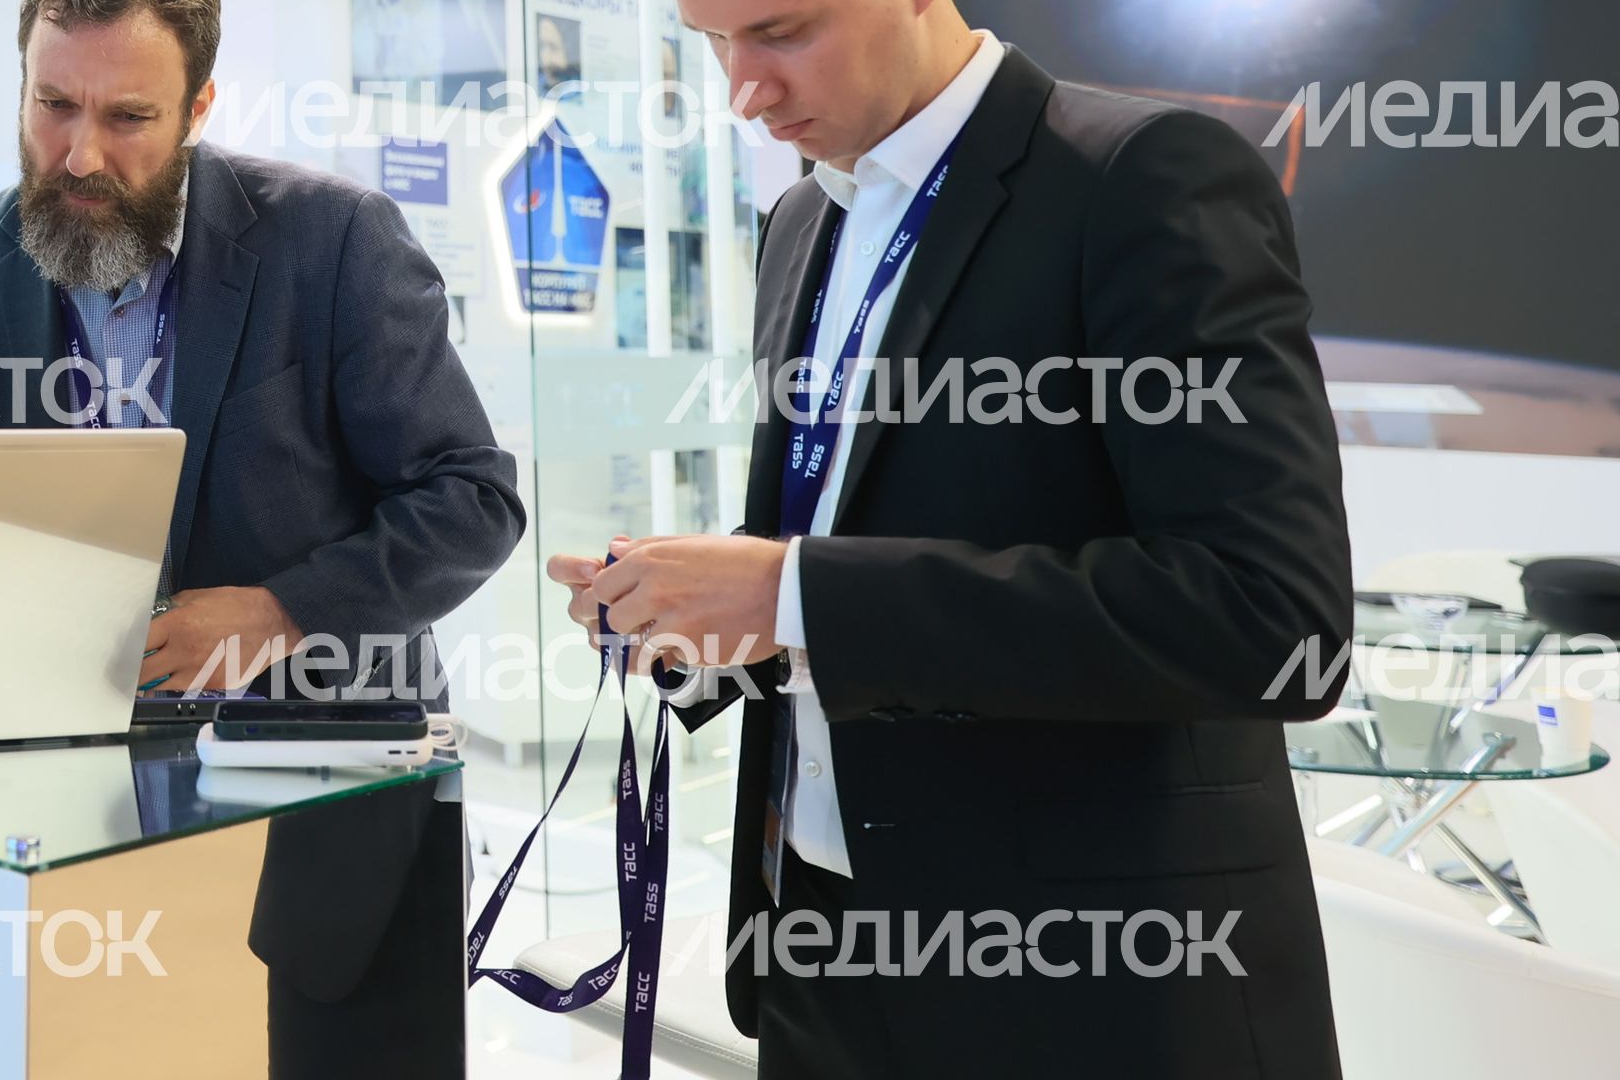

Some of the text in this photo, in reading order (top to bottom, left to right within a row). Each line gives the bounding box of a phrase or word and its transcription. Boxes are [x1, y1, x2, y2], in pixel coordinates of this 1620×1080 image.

[884, 230, 911, 264] ТАСС
[792, 433, 804, 469] TASS
[804, 444, 825, 478] TASS
[624, 842, 637, 883] ТАСС
[644, 881, 659, 923] TASS
[635, 971, 651, 1013] ТАСС
